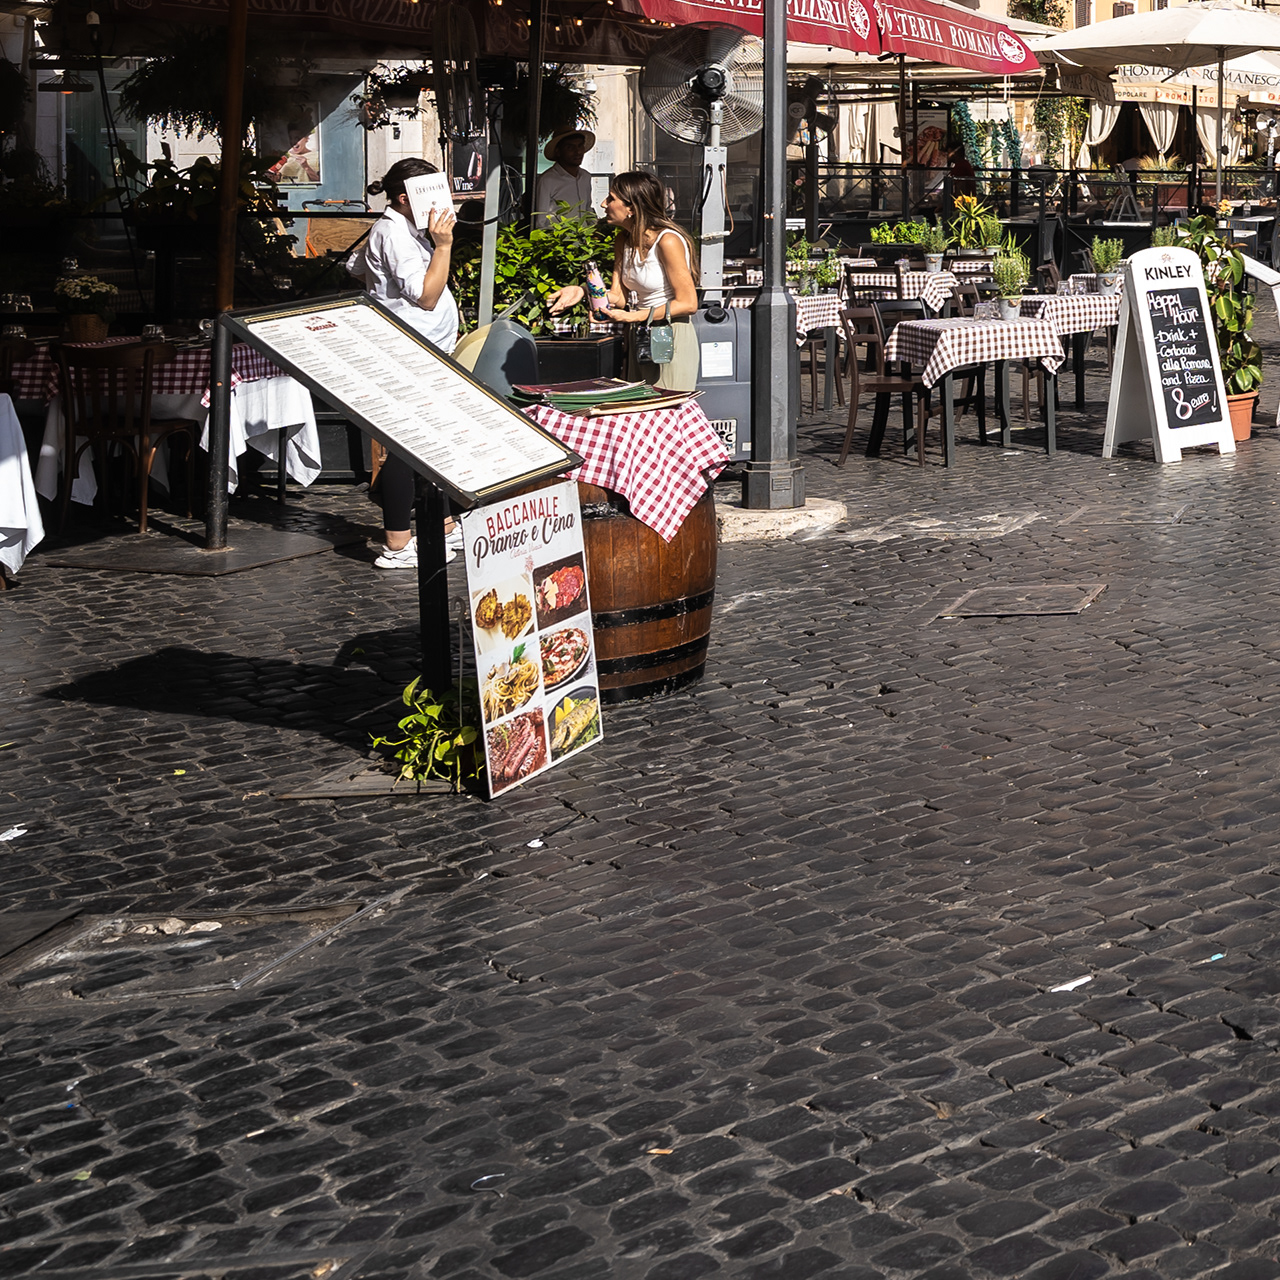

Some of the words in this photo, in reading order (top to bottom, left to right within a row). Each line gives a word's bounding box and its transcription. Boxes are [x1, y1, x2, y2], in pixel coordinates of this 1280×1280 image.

[949, 25, 1001, 57] ROMANA
[1166, 92, 1215, 103] ROMOLTTO
[1144, 265, 1191, 281] KINLEY
[1146, 292, 1183, 318] Happy
[1172, 306, 1199, 326] Hour
[1162, 373, 1182, 386] and
[1171, 388, 1193, 420] 8
[486, 497, 559, 539] BACCANALE
[473, 528, 529, 568] Pranzo
[531, 525, 539, 541] e
[542, 513, 576, 545] Cena
